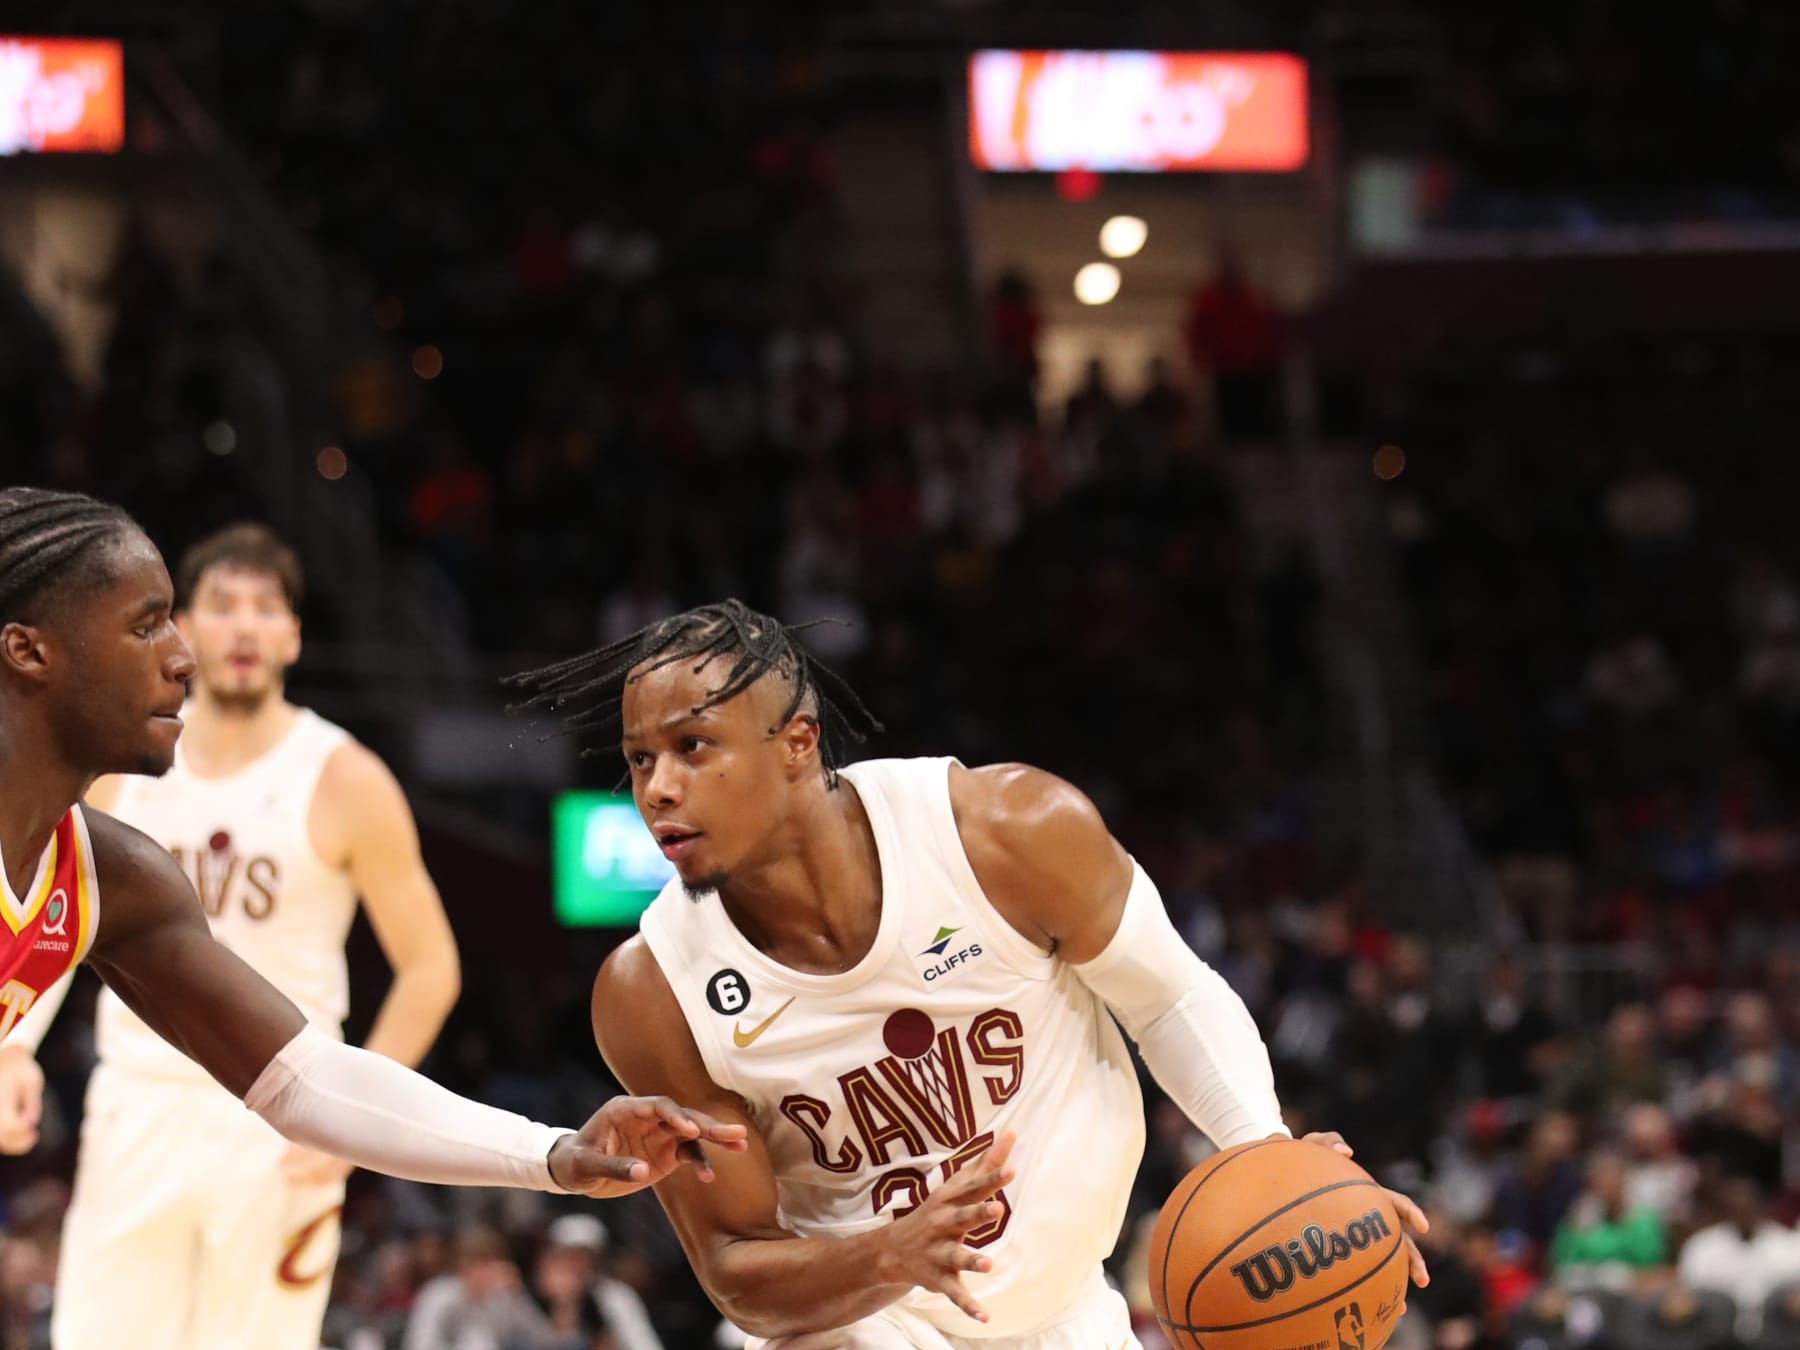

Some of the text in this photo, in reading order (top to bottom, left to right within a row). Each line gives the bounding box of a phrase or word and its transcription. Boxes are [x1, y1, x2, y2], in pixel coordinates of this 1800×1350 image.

[715, 974, 744, 1011] 6
[923, 943, 983, 981] CLIFFS
[779, 1007, 1024, 1173] CAVS
[1229, 1208, 1392, 1302] Wilson
